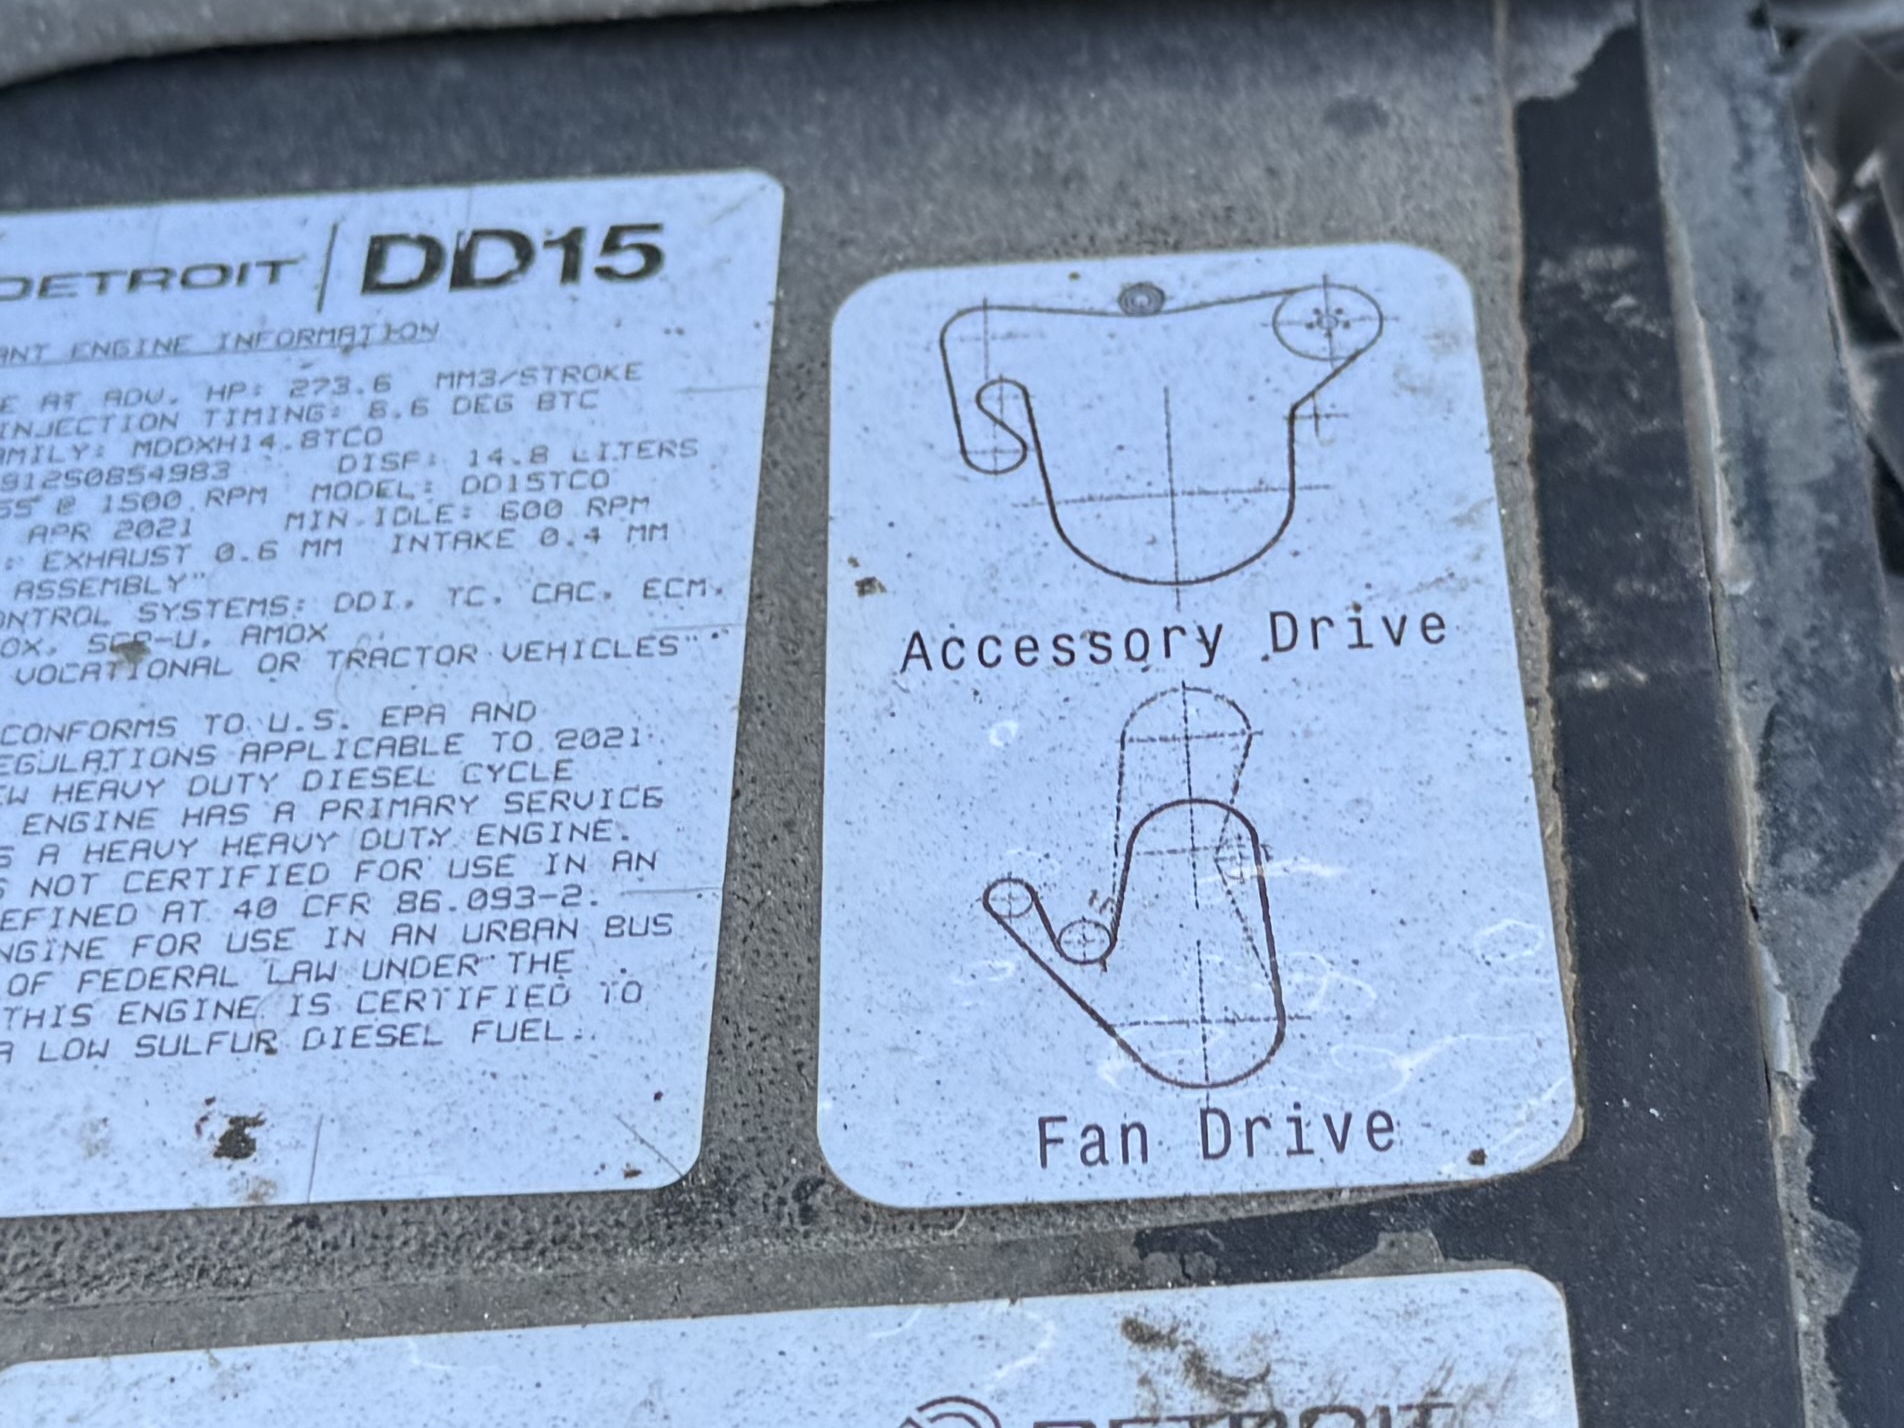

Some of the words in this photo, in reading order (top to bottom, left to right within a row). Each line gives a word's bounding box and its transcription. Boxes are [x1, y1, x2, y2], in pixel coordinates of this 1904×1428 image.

[360, 223, 666, 295] DD15
[69, 335, 192, 360] ENGINE
[452, 393, 514, 415] DEG
[98, 491, 182, 514] 1500
[204, 486, 267, 508] RPM
[112, 517, 197, 541] 2021
[586, 493, 649, 516] RPM
[41, 545, 192, 572] EXHAUST
[300, 537, 343, 559] MM
[387, 528, 516, 555] INTAKE
[627, 520, 669, 542] MM
[241, 621, 328, 646] AMOX
[900, 622, 1225, 674] Accessory
[1270, 606, 1448, 653] Drive
[13, 655, 234, 688] VOCATIONAL
[256, 652, 300, 675] OR
[323, 643, 478, 673] TRACTOR
[200, 713, 245, 736] TO
[380, 703, 447, 727] EPA
[471, 698, 538, 723] AND
[239, 732, 465, 766] APPLICABLE
[489, 729, 533, 754] TO
[557, 723, 647, 751] 2021
[51, 777, 164, 805] HEAVY
[187, 772, 277, 798] DUTY
[301, 764, 437, 793] DIESEL
[461, 757, 575, 785] CYCLE
[21, 808, 158, 837] ENGINE
[181, 804, 249, 829] HAS
[272, 801, 295, 825] A
[318, 792, 478, 823] PRIMARY
[503, 783, 663, 815] SERVICE
[37, 844, 60, 867] A
[83, 837, 197, 865] HEAVY
[221, 830, 335, 859] HEAVY
[359, 825, 451, 852] DUTY
[476, 816, 632, 847] ENGINE.
[29, 873, 99, 899] NOT
[122, 862, 330, 895] CERTIFIED
[354, 857, 423, 884] FOR
[447, 853, 516, 879] USE
[541, 849, 586, 875] IN
[611, 846, 656, 872] AN
[161, 900, 207, 925] AT
[231, 897, 277, 922] 40
[301, 892, 371, 919] CFR
[131, 933, 201, 959] FOR
[225, 929, 295, 955] USE
[319, 926, 365, 950] IN
[390, 922, 436, 947] AN
[461, 916, 578, 944] URBAN
[604, 911, 673, 937] BUS
[6, 972, 53, 998] OF
[77, 963, 242, 995] FEDERAL
[266, 959, 337, 986] LAW
[361, 952, 479, 981] UNDER
[505, 948, 575, 975] THE
[117, 995, 259, 1026] ENGINE
[284, 992, 331, 1018] IS
[356, 980, 570, 1015] CERTIFIED
[597, 977, 642, 1004] TO
[37, 1037, 109, 1064] LOW
[133, 1029, 276, 1060] SULFUR
[301, 1021, 445, 1052] DIESEL
[1035, 1114, 1151, 1168] Fan
[1199, 1104, 1397, 1161] Drive
